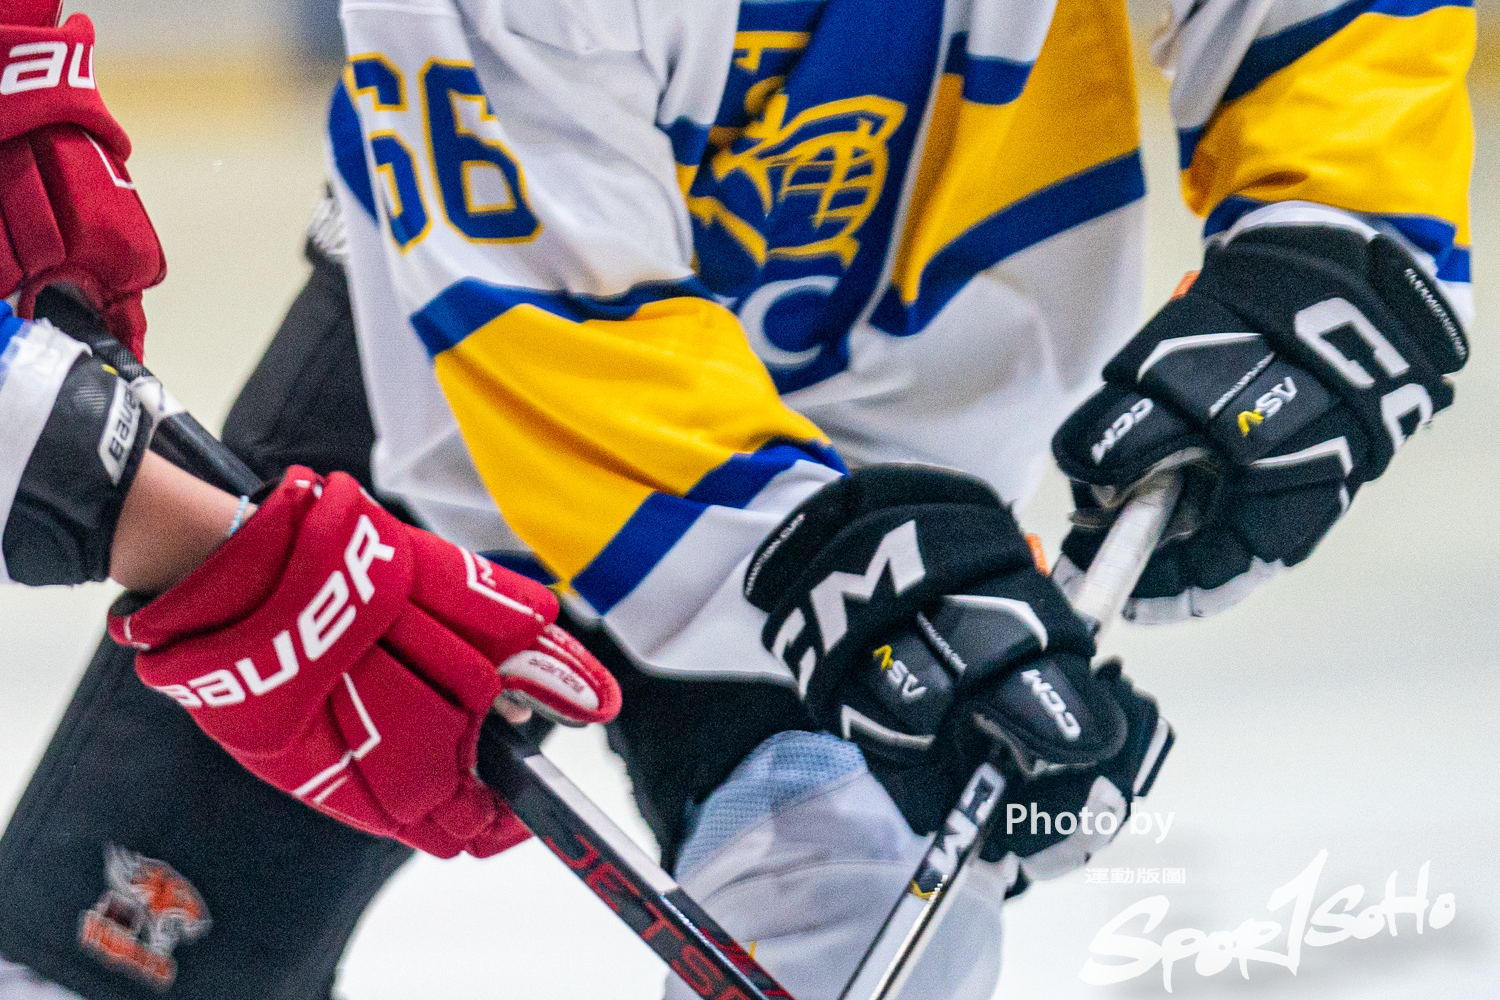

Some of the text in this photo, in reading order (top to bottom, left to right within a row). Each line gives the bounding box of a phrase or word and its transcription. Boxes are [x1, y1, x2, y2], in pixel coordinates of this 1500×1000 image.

[328, 50, 545, 257] 66
[1091, 397, 1154, 465] CCM
[1021, 668, 1082, 742] CCM
